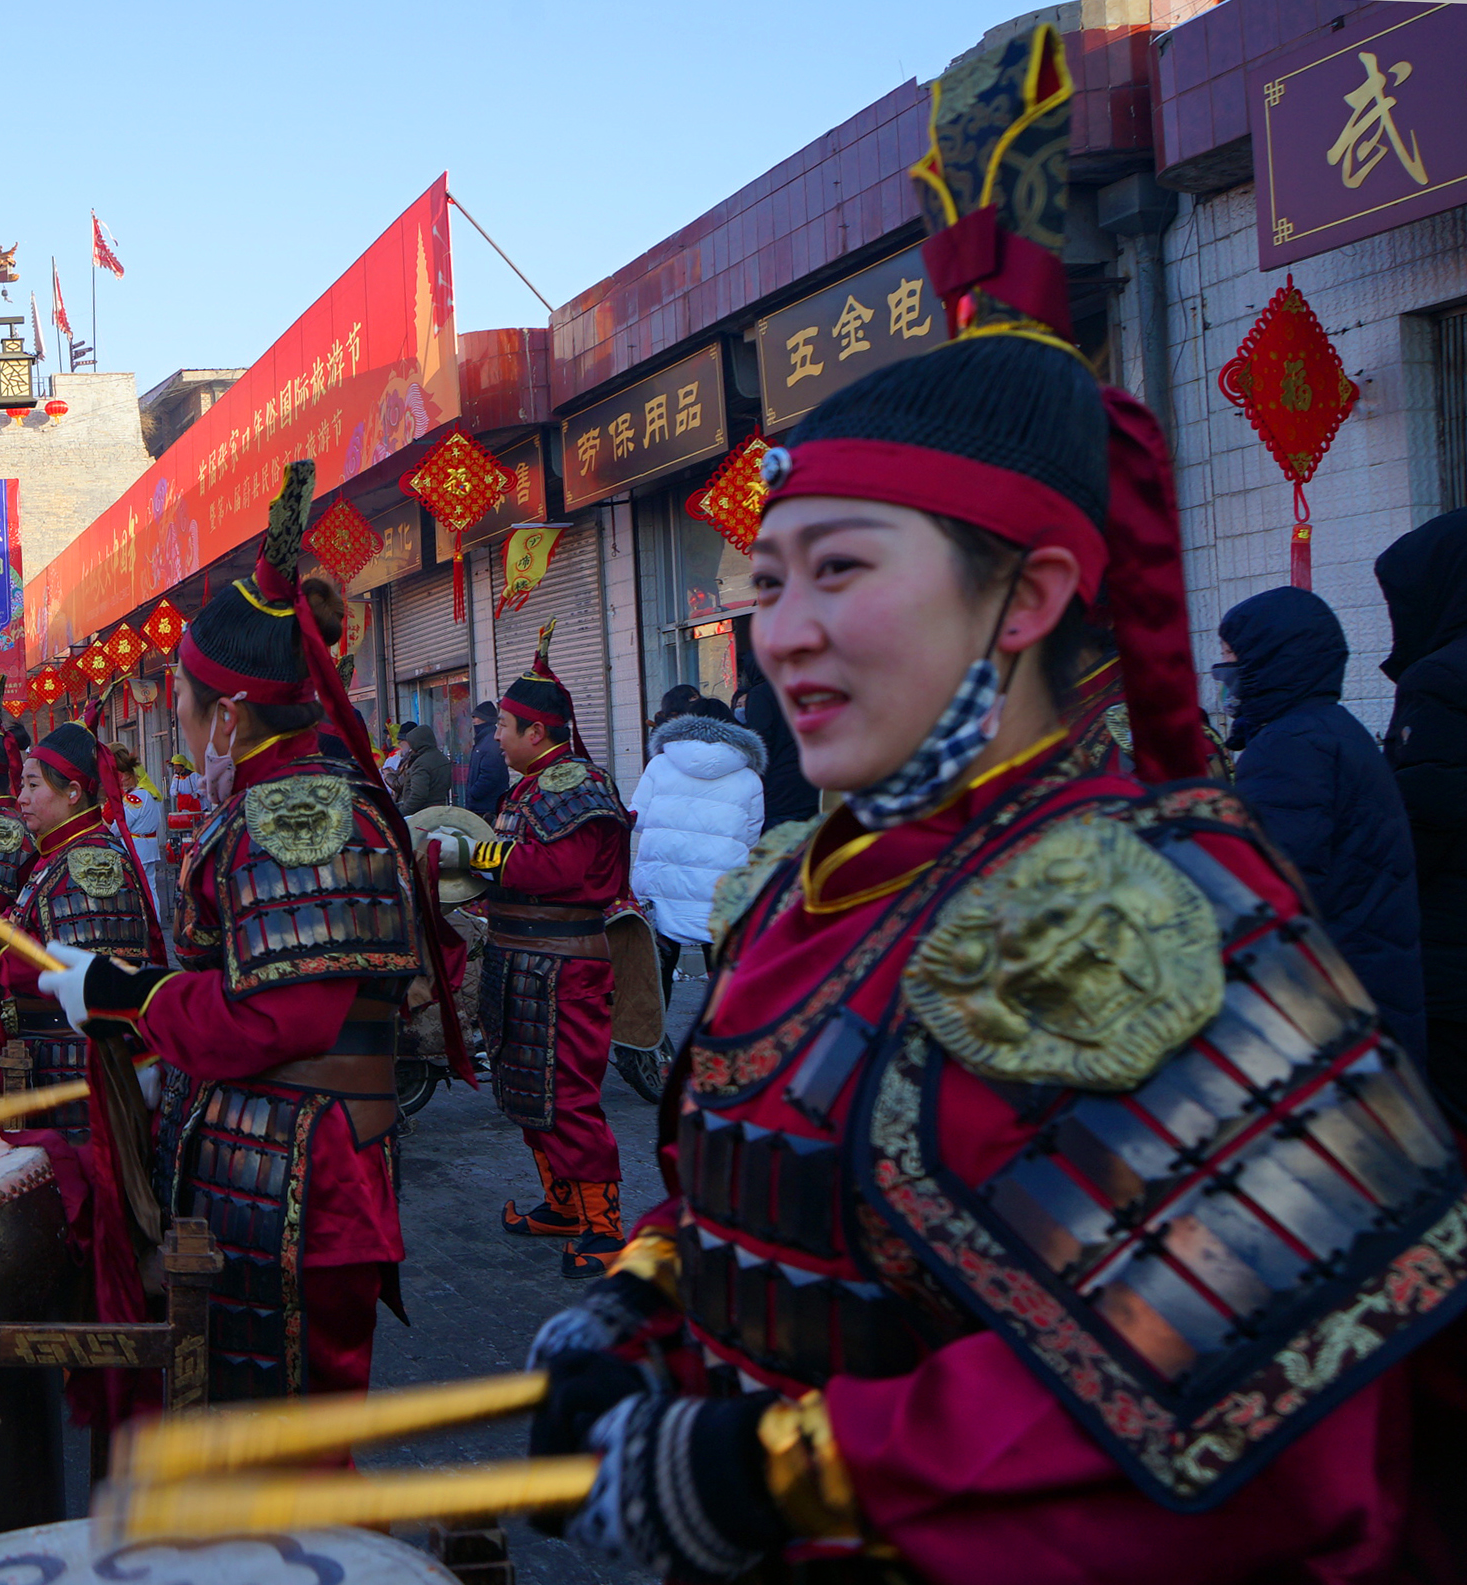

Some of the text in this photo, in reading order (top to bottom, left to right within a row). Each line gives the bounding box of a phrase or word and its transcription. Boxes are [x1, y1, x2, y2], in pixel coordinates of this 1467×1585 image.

[1326, 51, 1429, 190] 武
[785, 276, 932, 388] 五金电
[197, 322, 361, 497] 首届张家口年俗国际旅游节
[577, 380, 702, 477] 劳保用品
